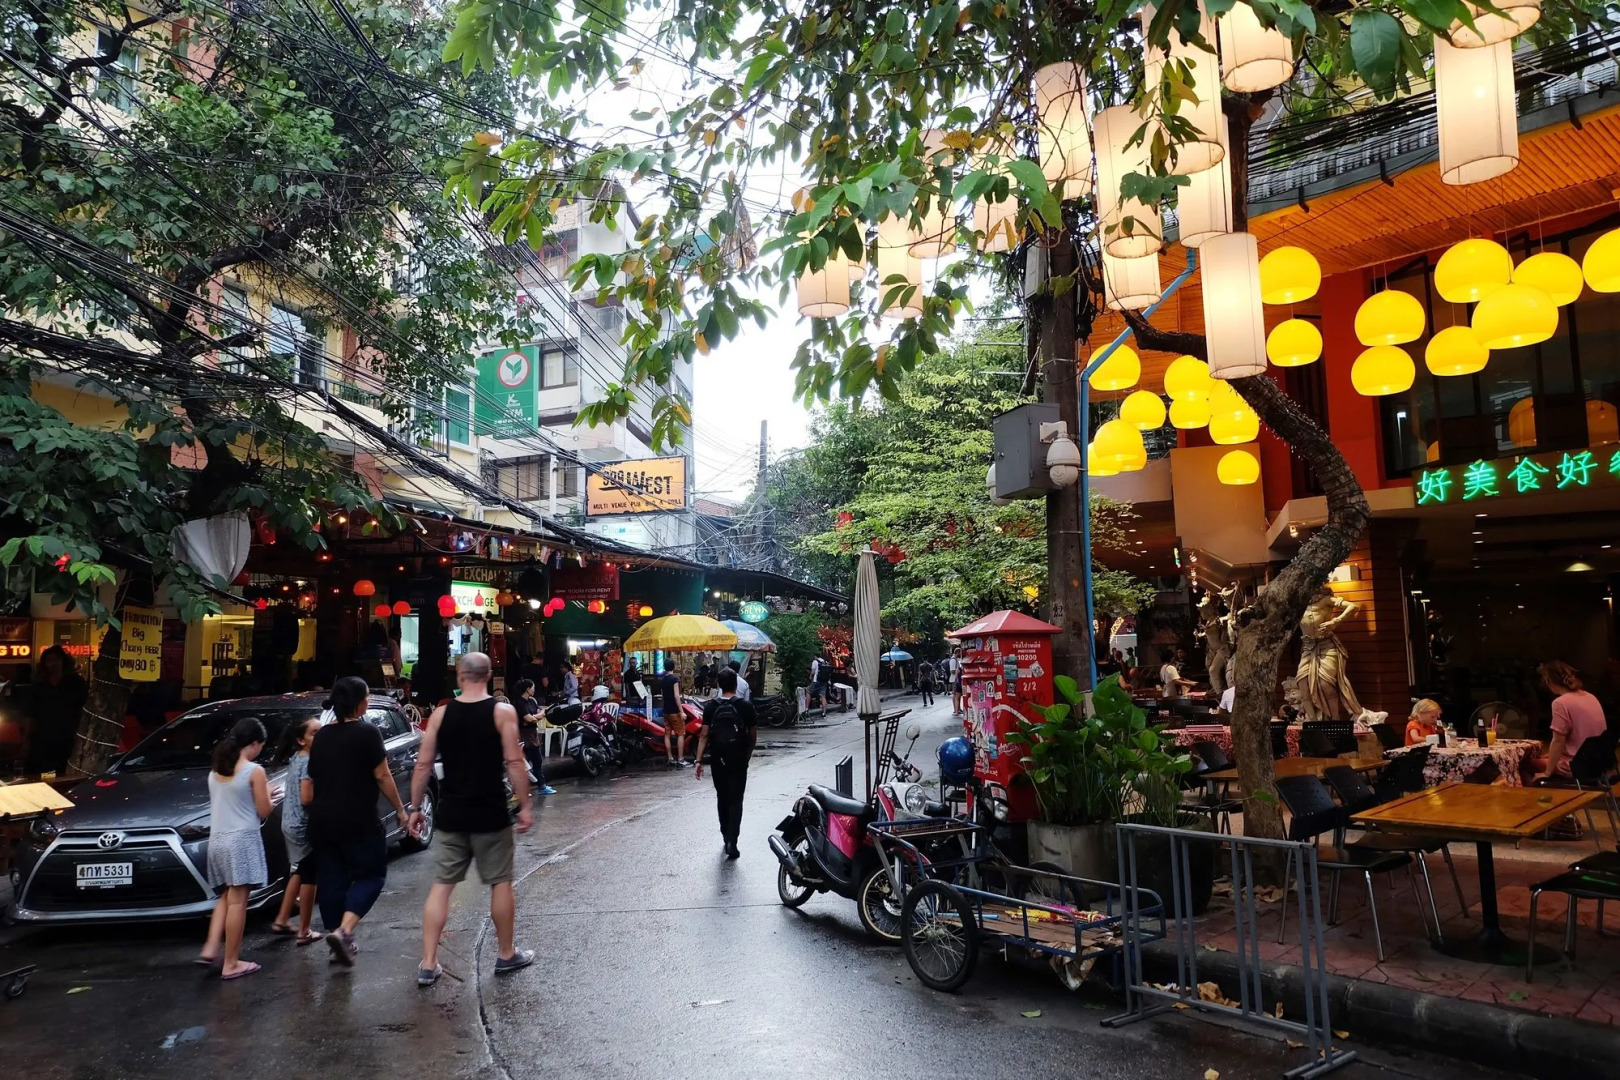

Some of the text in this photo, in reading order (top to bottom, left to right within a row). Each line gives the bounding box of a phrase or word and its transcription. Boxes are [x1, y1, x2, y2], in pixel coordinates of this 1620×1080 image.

[627, 471, 673, 495] WEST
[132, 627, 145, 641] Big
[11, 645, 30, 656] TO
[135, 658, 147, 670] 80
[1023, 682, 1037, 691] 2/2
[104, 865, 130, 876] 5331
